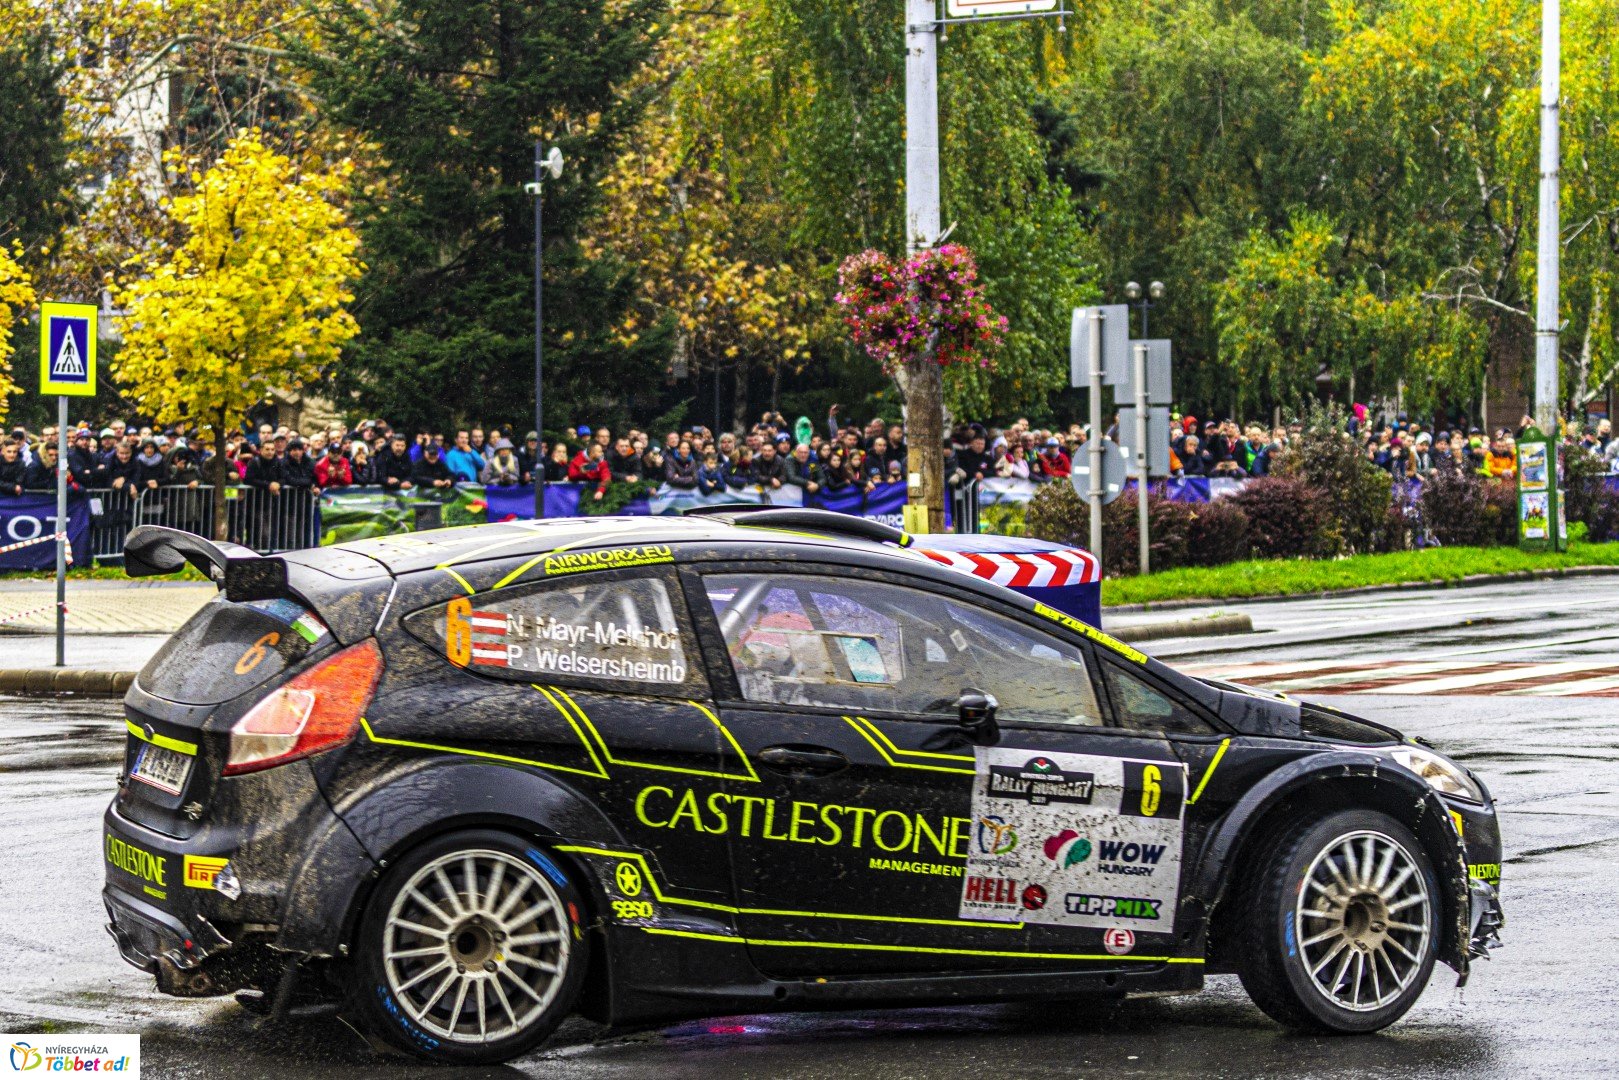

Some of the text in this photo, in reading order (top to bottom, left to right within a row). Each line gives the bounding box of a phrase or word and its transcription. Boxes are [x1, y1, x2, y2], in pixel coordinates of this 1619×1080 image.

[0, 515, 71, 541] OT
[544, 545, 672, 569] AIRWORX.EU
[446, 594, 473, 668] 6
[506, 614, 529, 638] N.
[234, 631, 280, 675] 6
[507, 644, 686, 682] P. Welsersheimb
[992, 773, 1031, 793] RALLY
[1140, 764, 1162, 817] 6
[635, 785, 971, 858] CASTLESTONE
[106, 833, 167, 887] CASTLESTONE
[1098, 840, 1167, 865] WOW
[1097, 864, 1155, 877] HUNGARY
[965, 876, 1017, 904] HELL
[1113, 933, 1125, 948] E
